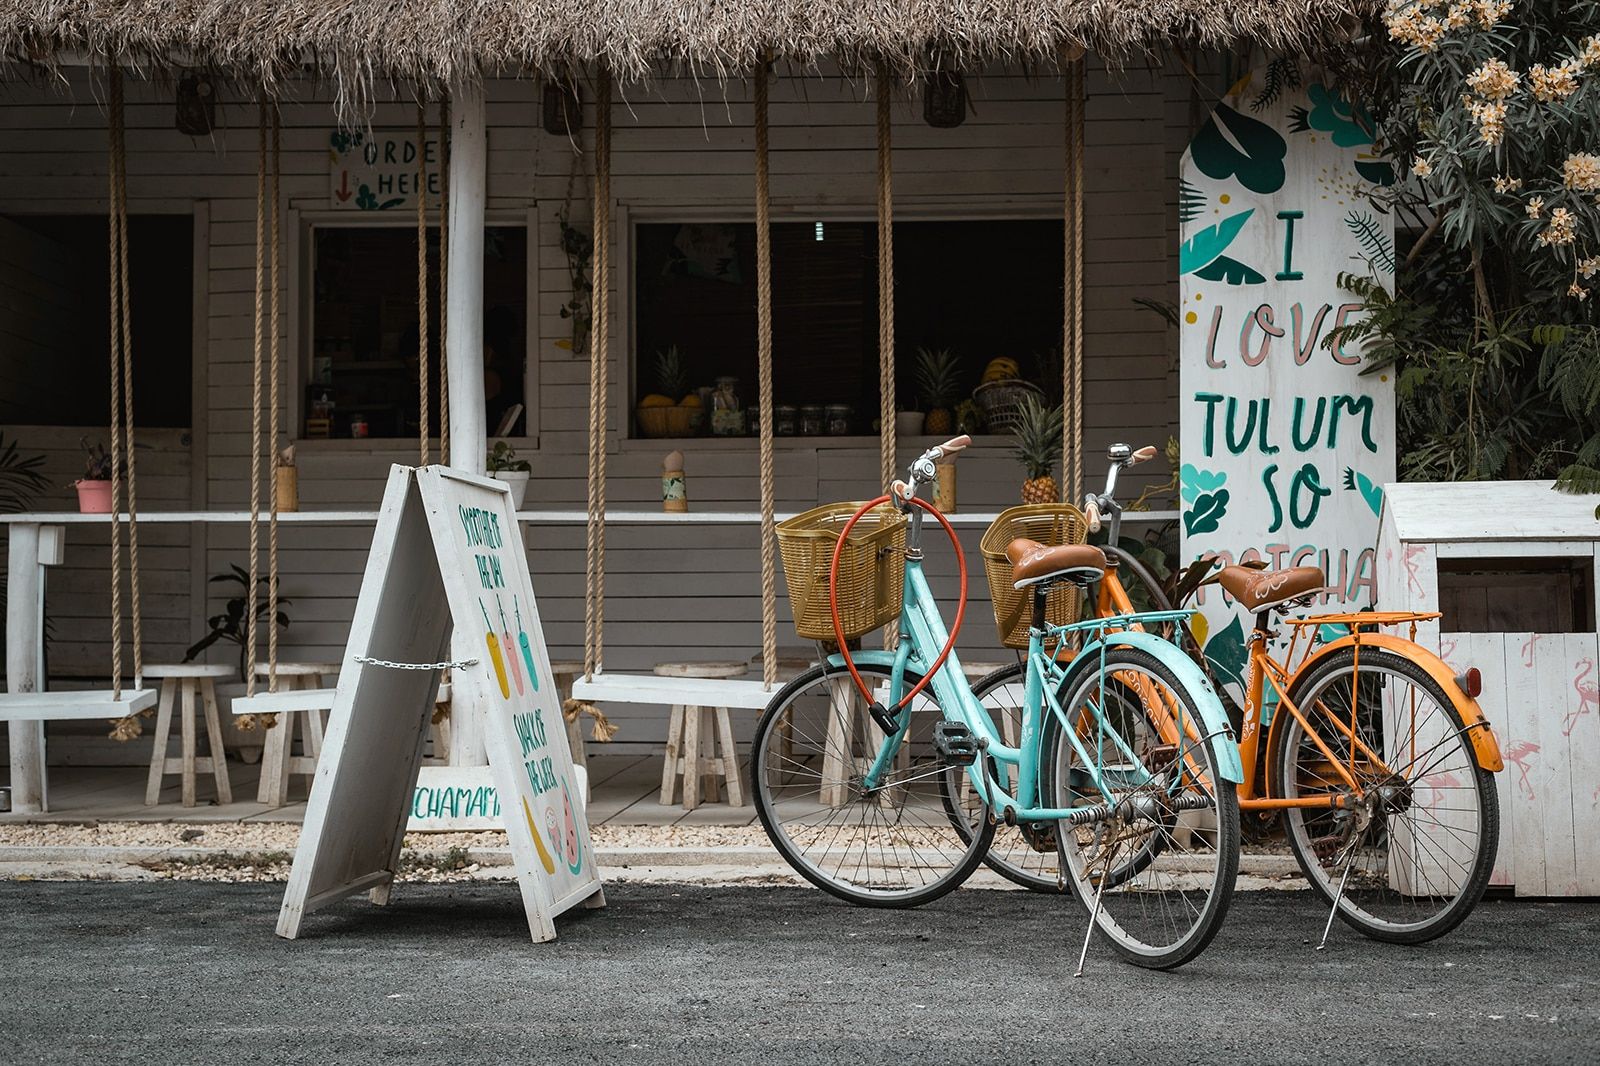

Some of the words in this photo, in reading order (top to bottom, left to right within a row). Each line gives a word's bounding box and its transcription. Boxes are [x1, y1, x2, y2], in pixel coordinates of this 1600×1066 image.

[364, 140, 450, 165] ORDE
[1275, 210, 1304, 281] I
[1206, 302, 1365, 369] LOVE
[1194, 392, 1378, 457] TULUM
[1261, 462, 1331, 533] SO
[408, 786, 500, 819] CHAMAM
